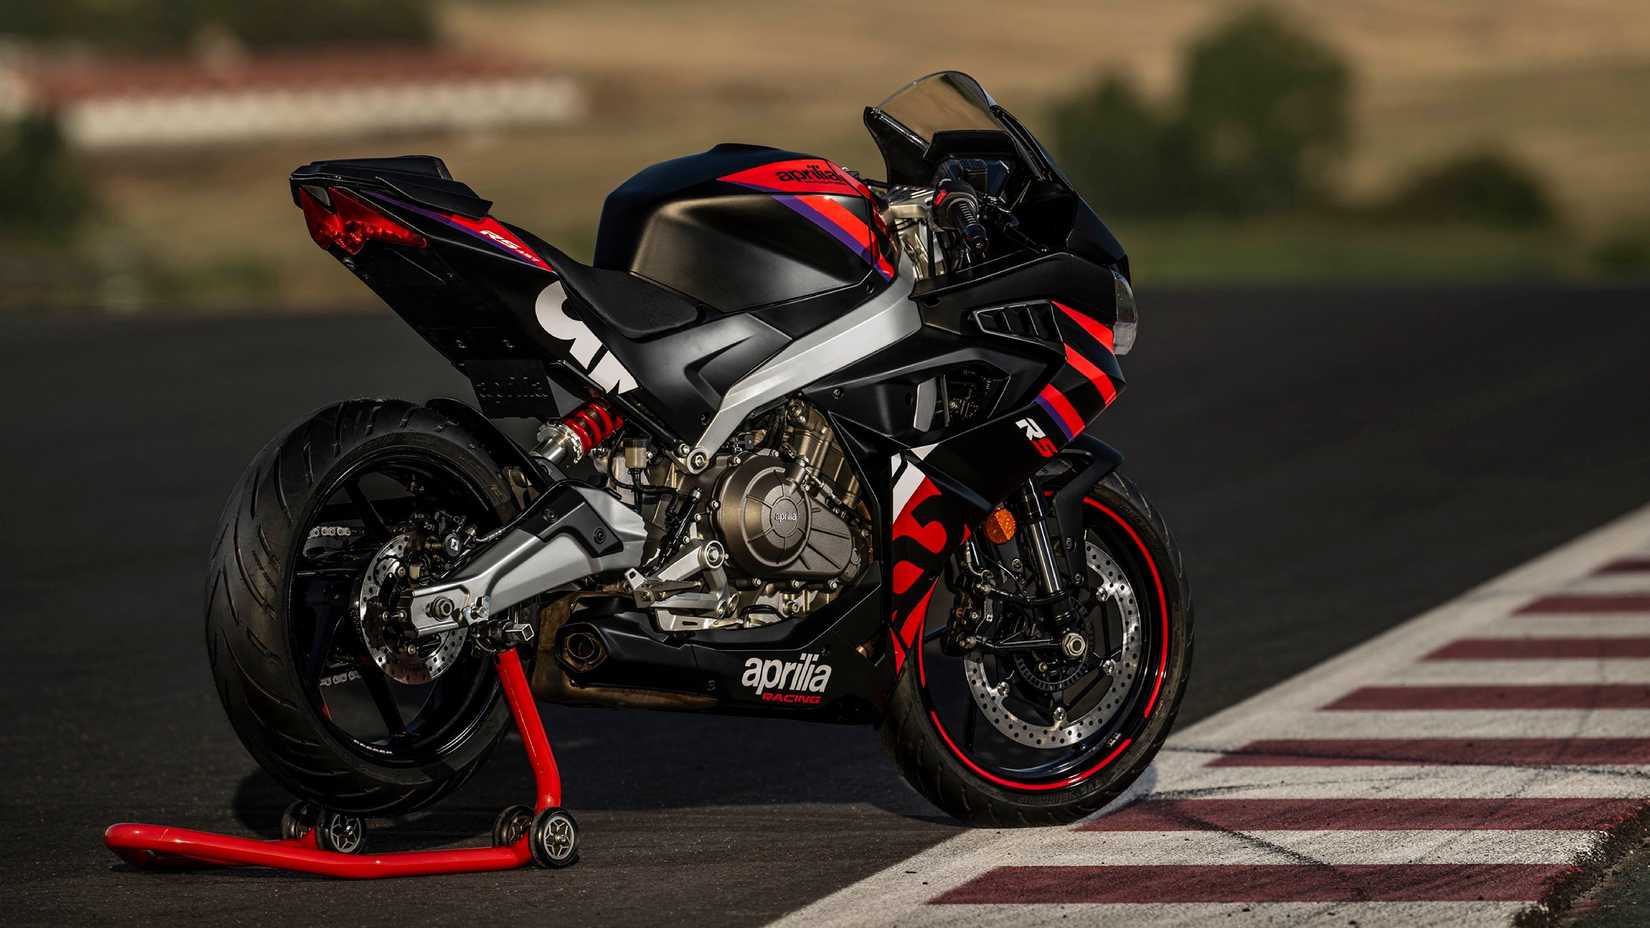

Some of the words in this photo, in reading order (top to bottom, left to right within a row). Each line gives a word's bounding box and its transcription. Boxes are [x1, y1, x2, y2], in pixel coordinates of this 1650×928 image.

[776, 164, 840, 183] aprilia
[1015, 417, 1058, 458] RS
[741, 653, 832, 695] aprilia
[762, 692, 821, 704] RACING
